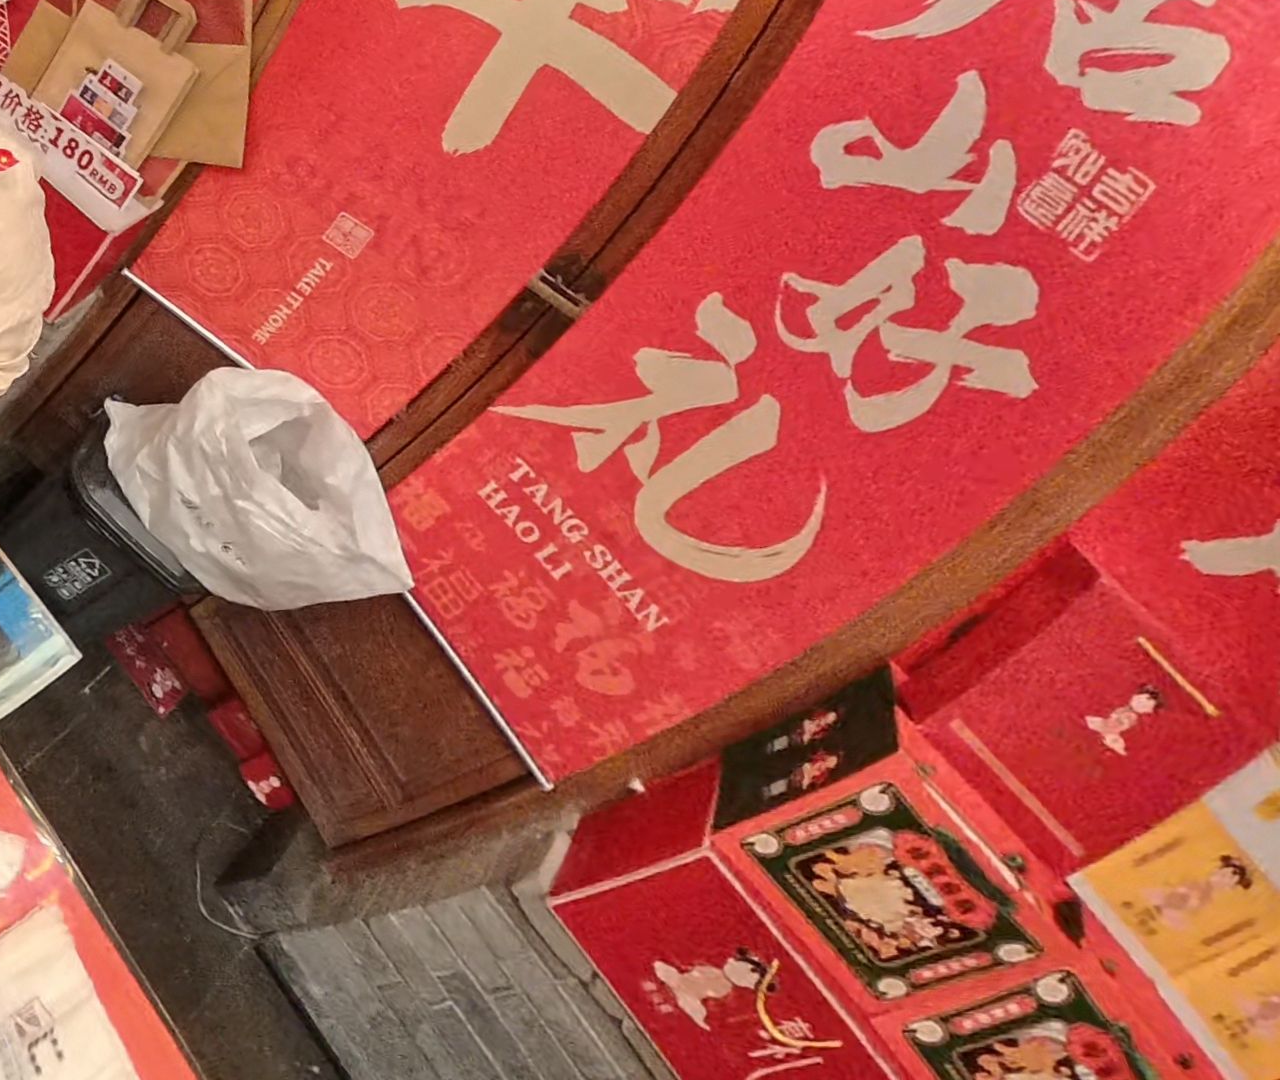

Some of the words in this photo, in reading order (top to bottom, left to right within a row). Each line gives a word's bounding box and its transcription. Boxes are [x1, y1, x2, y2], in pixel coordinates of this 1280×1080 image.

[296, 257, 334, 297] TAKE
[251, 304, 293, 346] HOME
[477, 480, 540, 545] HAO
[534, 542, 573, 582] LI
[508, 457, 589, 546] TANG
[583, 543, 669, 633] SHAN
